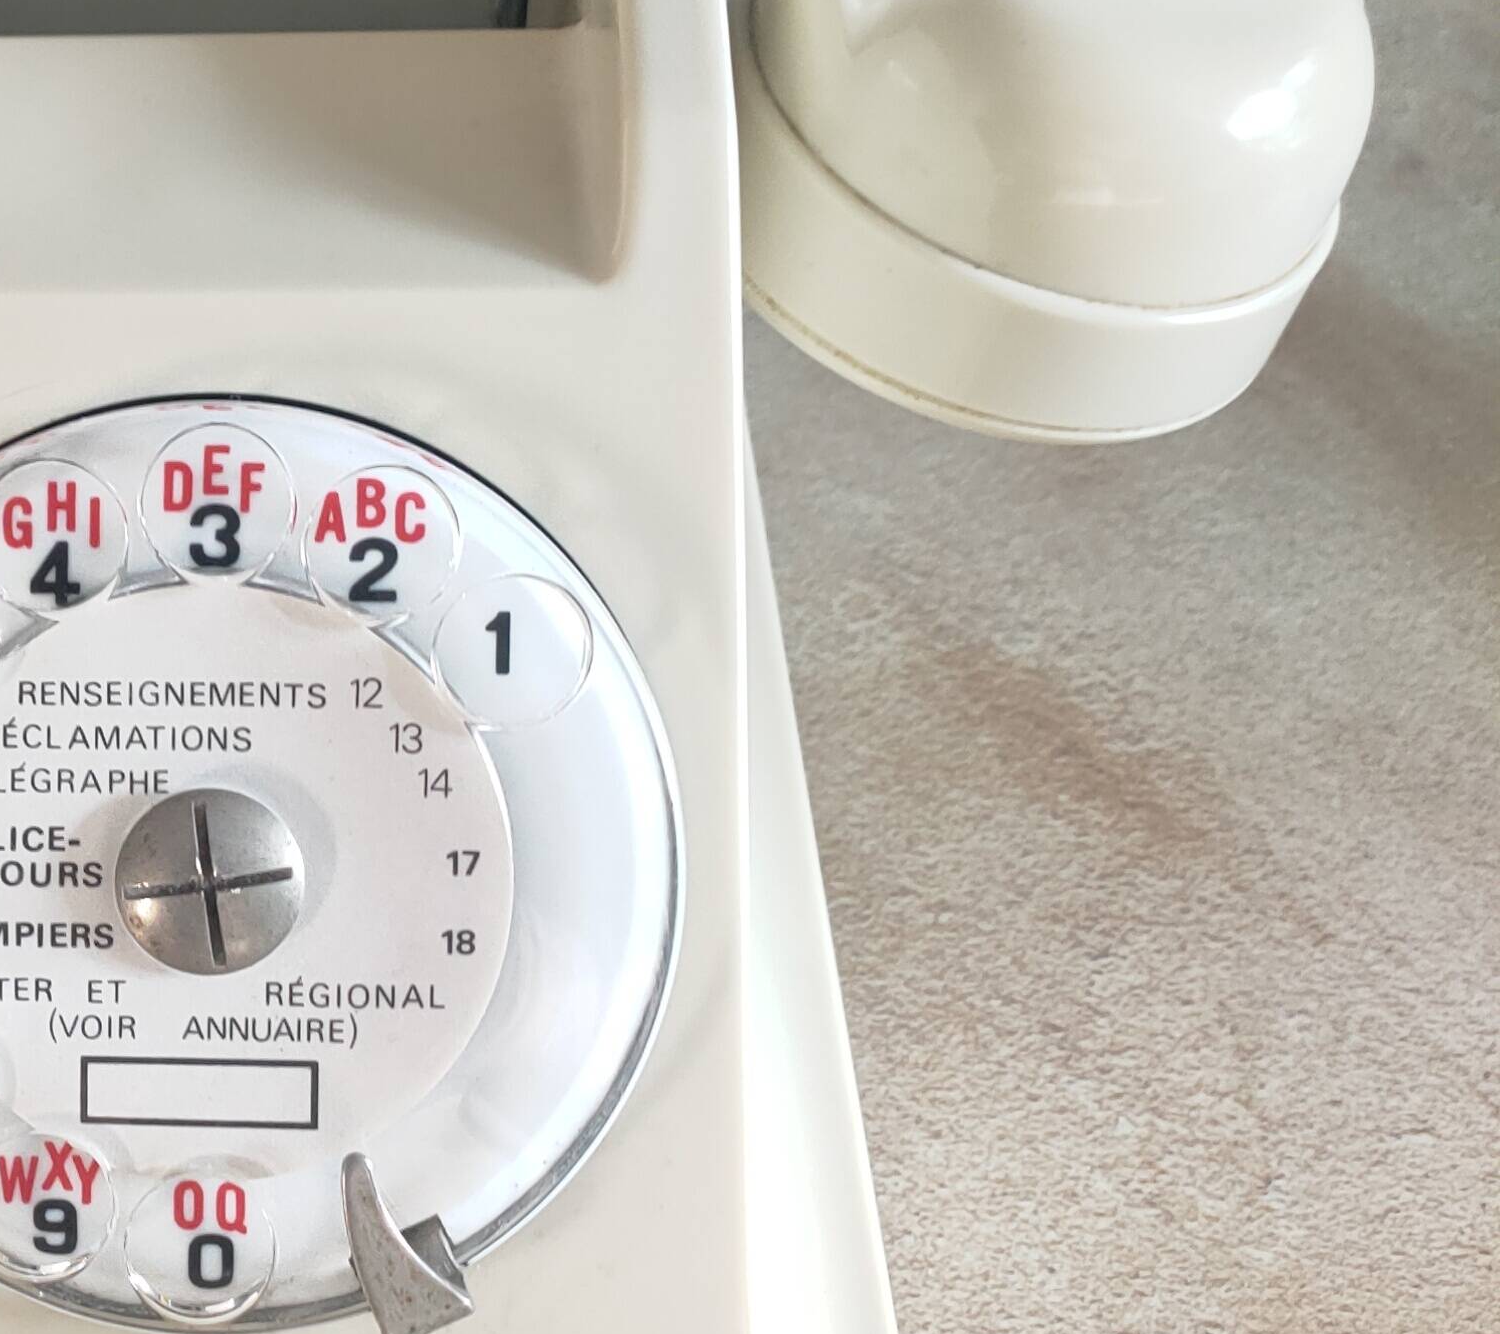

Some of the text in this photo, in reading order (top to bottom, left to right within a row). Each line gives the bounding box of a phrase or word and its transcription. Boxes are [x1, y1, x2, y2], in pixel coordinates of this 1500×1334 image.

[163, 444, 265, 512] DEF
[2, 481, 101, 548] GHI
[189, 503, 241, 567] 3
[314, 478, 426, 543] ABC
[30, 541, 80, 607] 4
[348, 539, 398, 602] 2
[485, 611, 511, 675] 1
[18, 678, 384, 709] RENSEIGNEMENTS 12
[390, 724, 423, 754] 13
[419, 769, 453, 798] 14
[446, 850, 480, 876] 17
[441, 930, 476, 954] 18
[88, 980, 126, 1003] ET
[265, 977, 445, 1009] RÉGIONAL
[49, 1007, 358, 1049] (VOIR ANNUAIRE)
[33, 1199, 78, 1254] 9
[187, 1235, 235, 1288] 0
